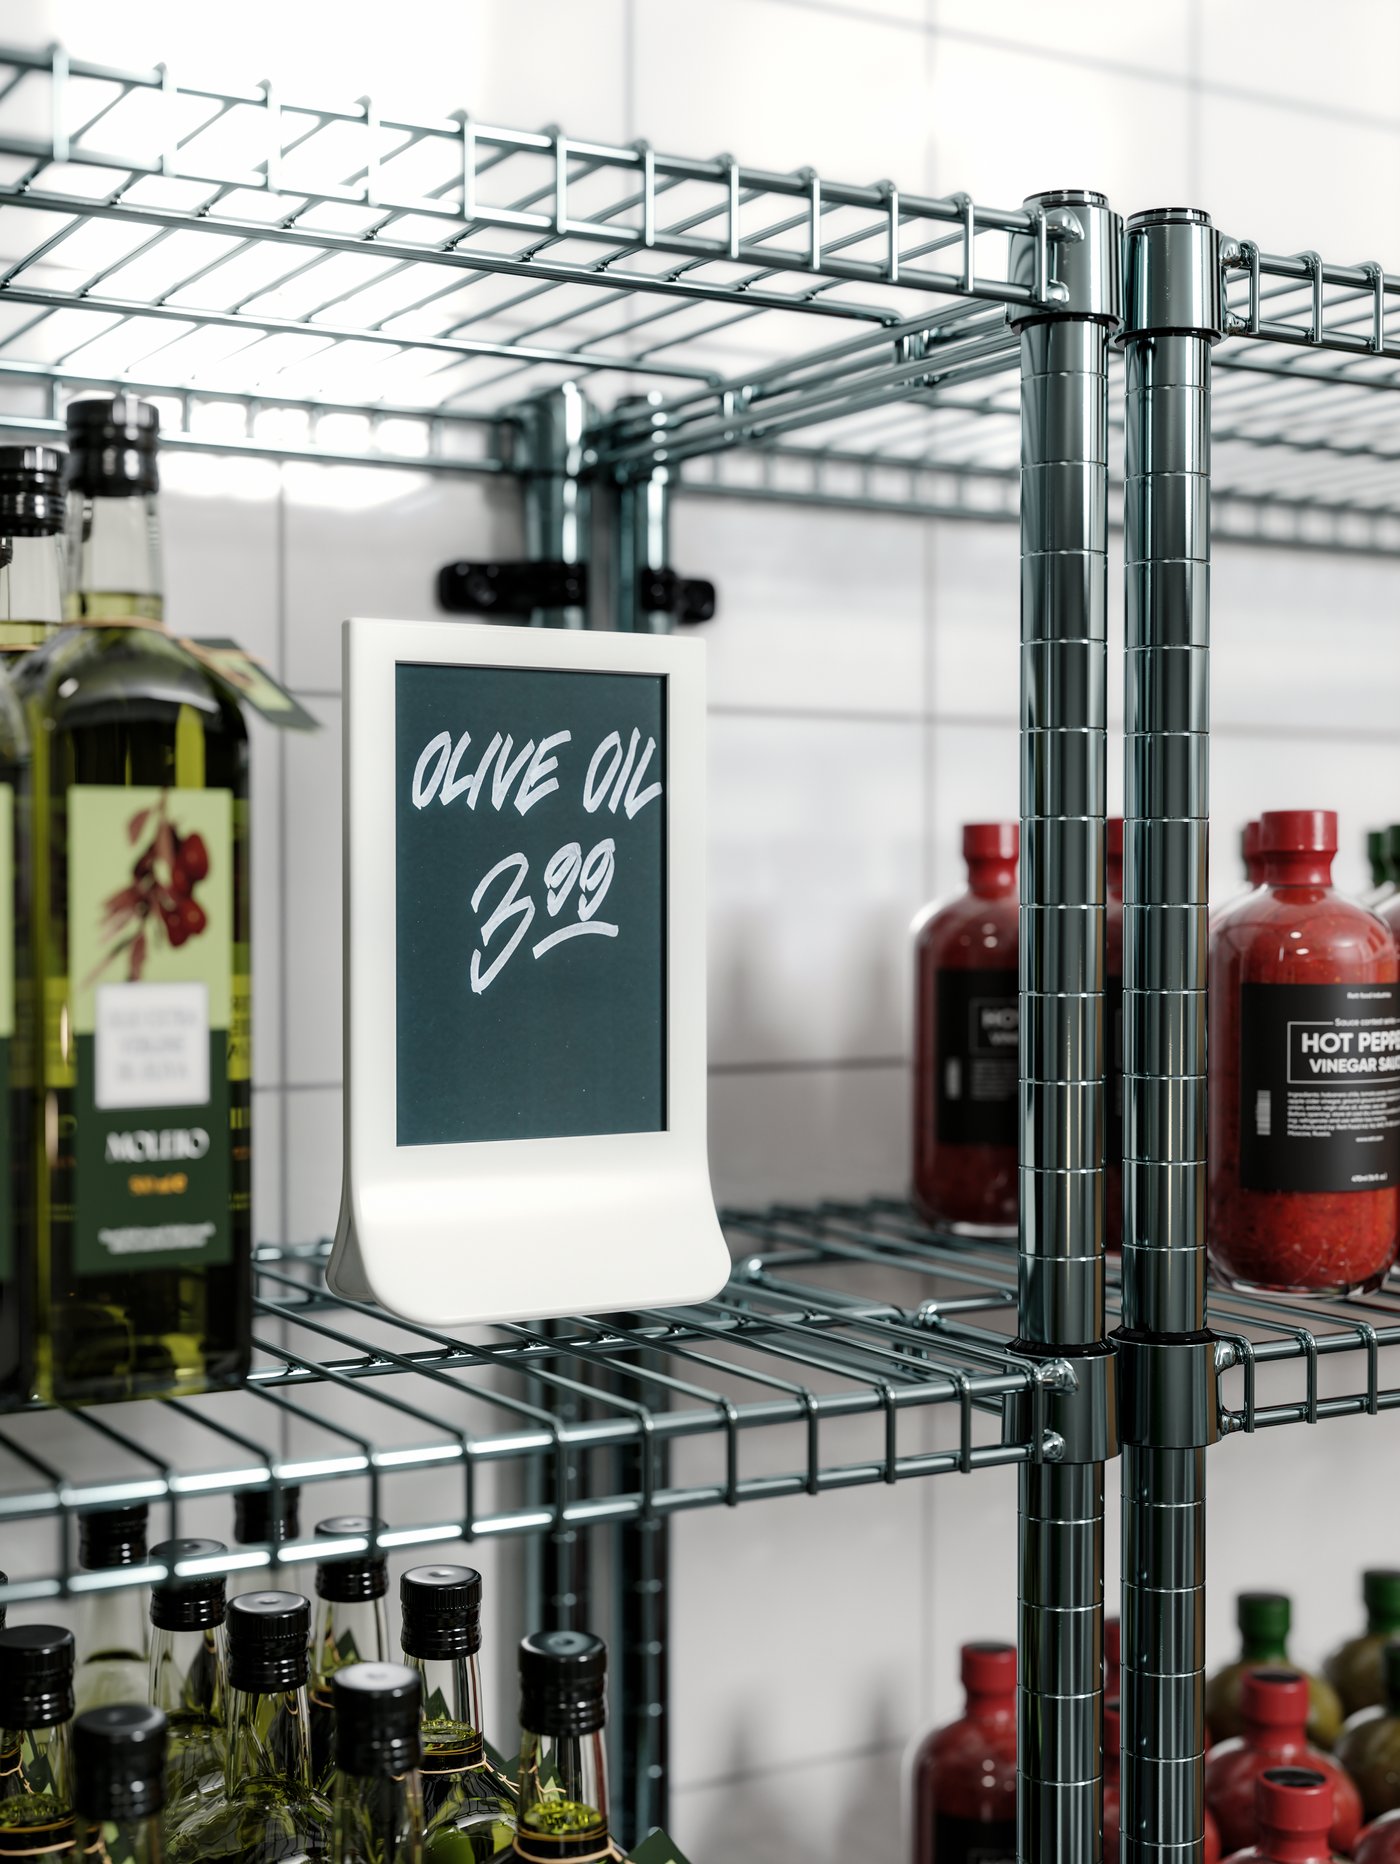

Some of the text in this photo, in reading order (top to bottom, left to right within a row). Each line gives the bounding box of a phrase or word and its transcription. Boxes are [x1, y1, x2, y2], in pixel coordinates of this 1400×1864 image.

[411, 726, 662, 820] OLIVE OIL
[1334, 1017, 1360, 1027] Sauce
[1301, 1029, 1400, 1054] HOT PEPPE
[1308, 1056, 1377, 1074] VINEGAR
